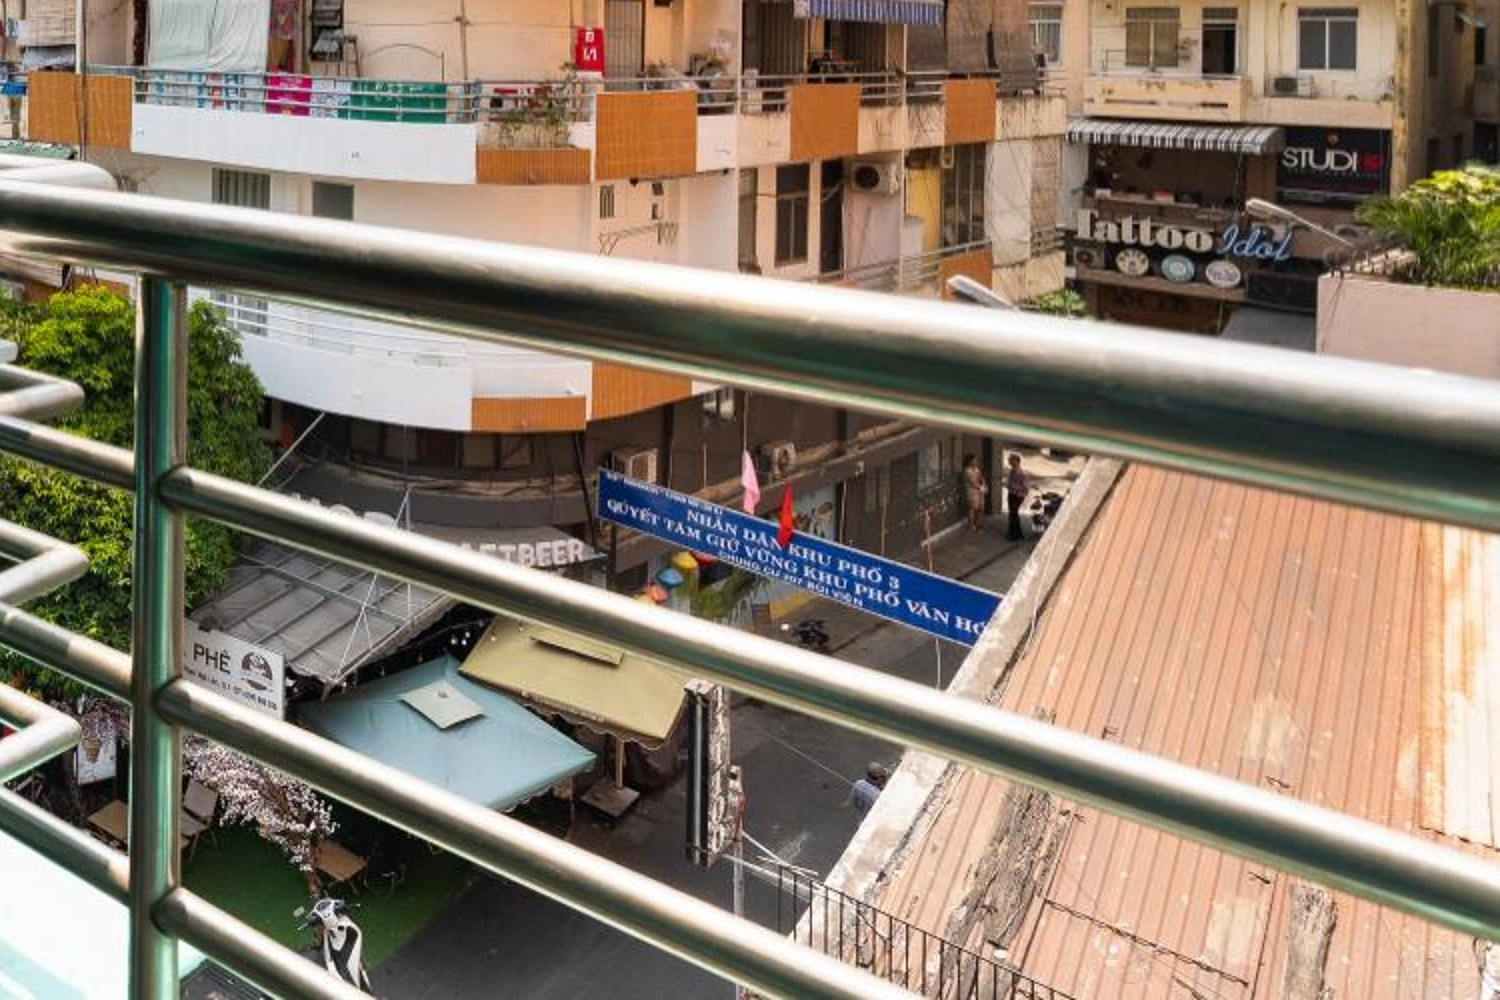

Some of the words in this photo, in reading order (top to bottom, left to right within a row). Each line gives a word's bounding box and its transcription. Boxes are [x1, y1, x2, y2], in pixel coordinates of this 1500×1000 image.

[1077, 208, 1214, 253] Tattoo
[1216, 223, 1295, 261] Idol
[664, 518, 701, 541] TÂM
[804, 566, 847, 589] KHU
[855, 582, 900, 607] PHỐ
[955, 615, 986, 635] HÓ
[687, 510, 738, 537] NHÂN
[789, 543, 832, 566] KHU
[838, 558, 882, 583] PHỐ
[889, 575, 900, 591] 3
[193, 642, 231, 675] PHÊ
